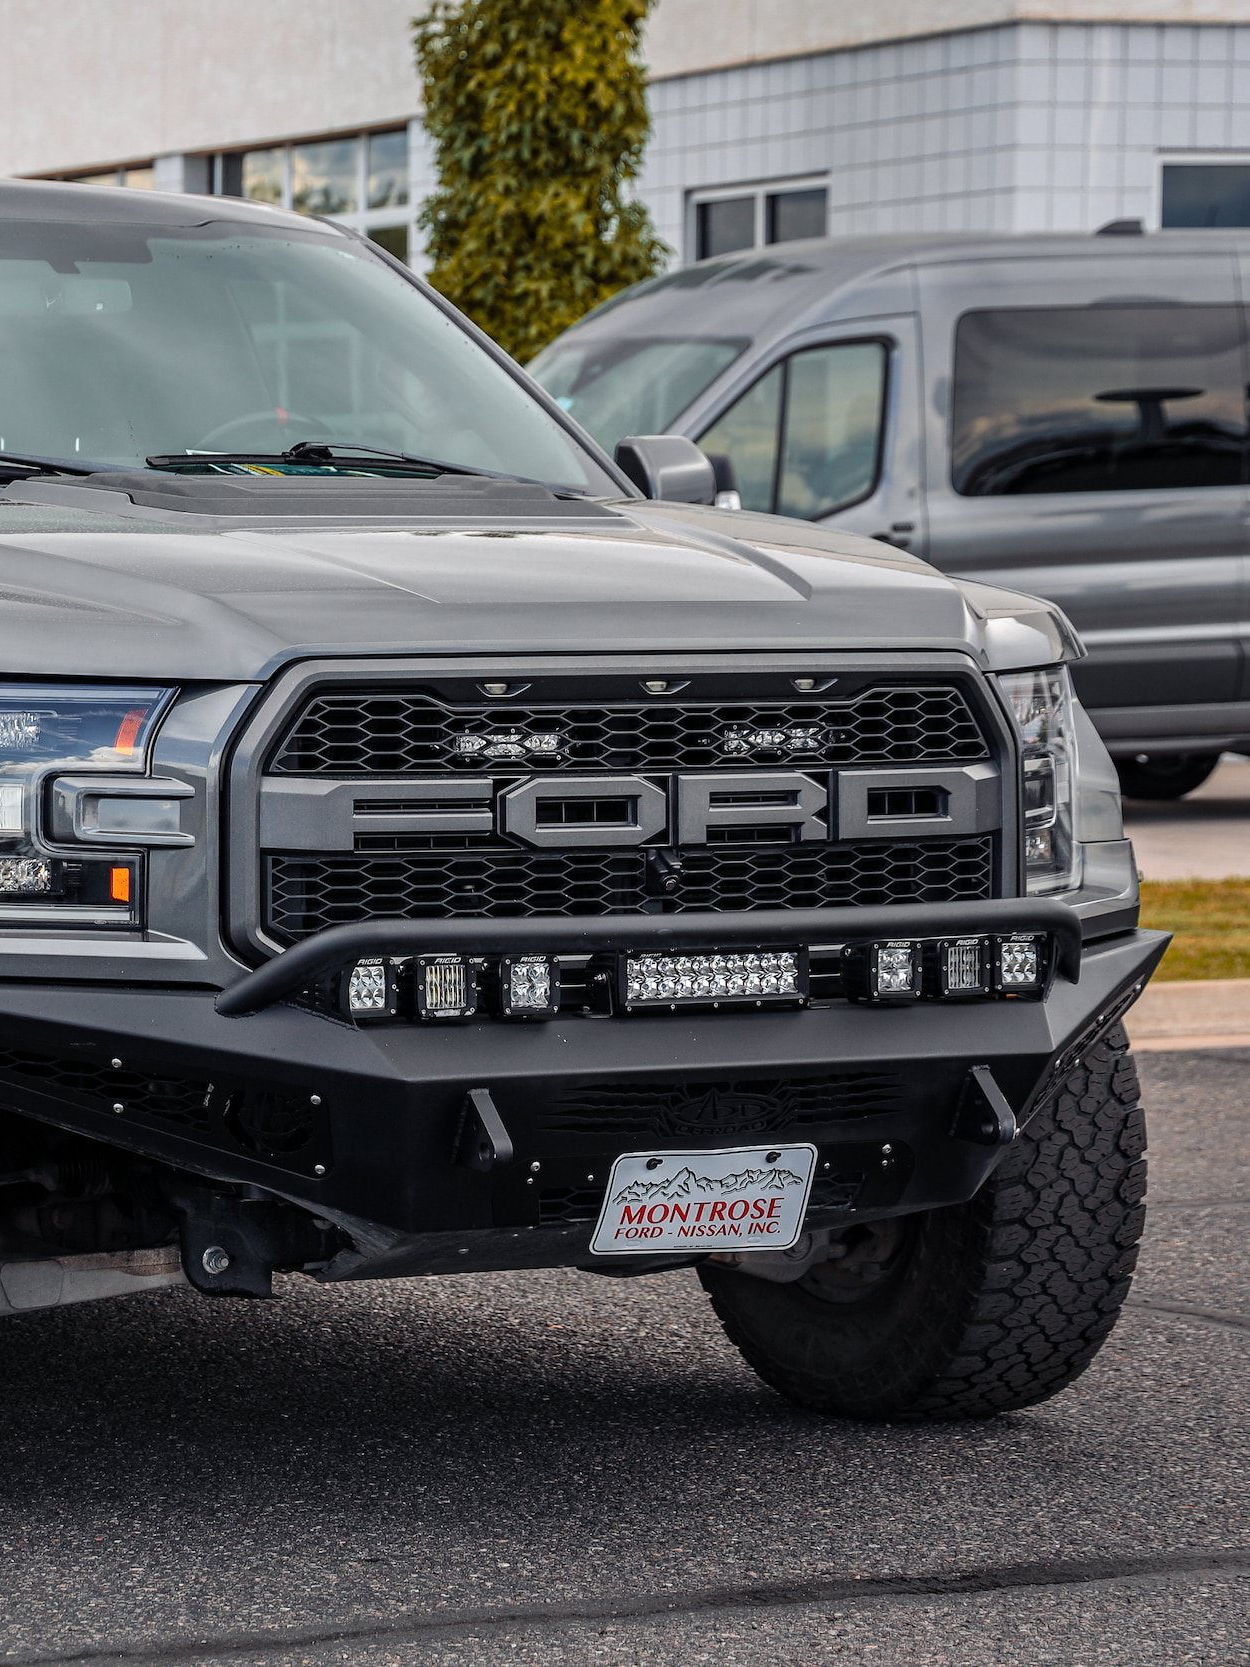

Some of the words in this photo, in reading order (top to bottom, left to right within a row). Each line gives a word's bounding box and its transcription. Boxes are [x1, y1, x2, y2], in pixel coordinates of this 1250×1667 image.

[260, 766, 1001, 850] FORD
[955, 938, 980, 946] RIGID
[1010, 934, 1035, 942] RIGID
[356, 957, 383, 965] RIGID
[434, 956, 461, 965] RIGID
[520, 955, 547, 963] RIGID
[619, 1197, 785, 1225] MONTROSE
[613, 1226, 664, 1240] FORD
[677, 1222, 743, 1238] NISSAN,
[747, 1221, 781, 1235] INC.
